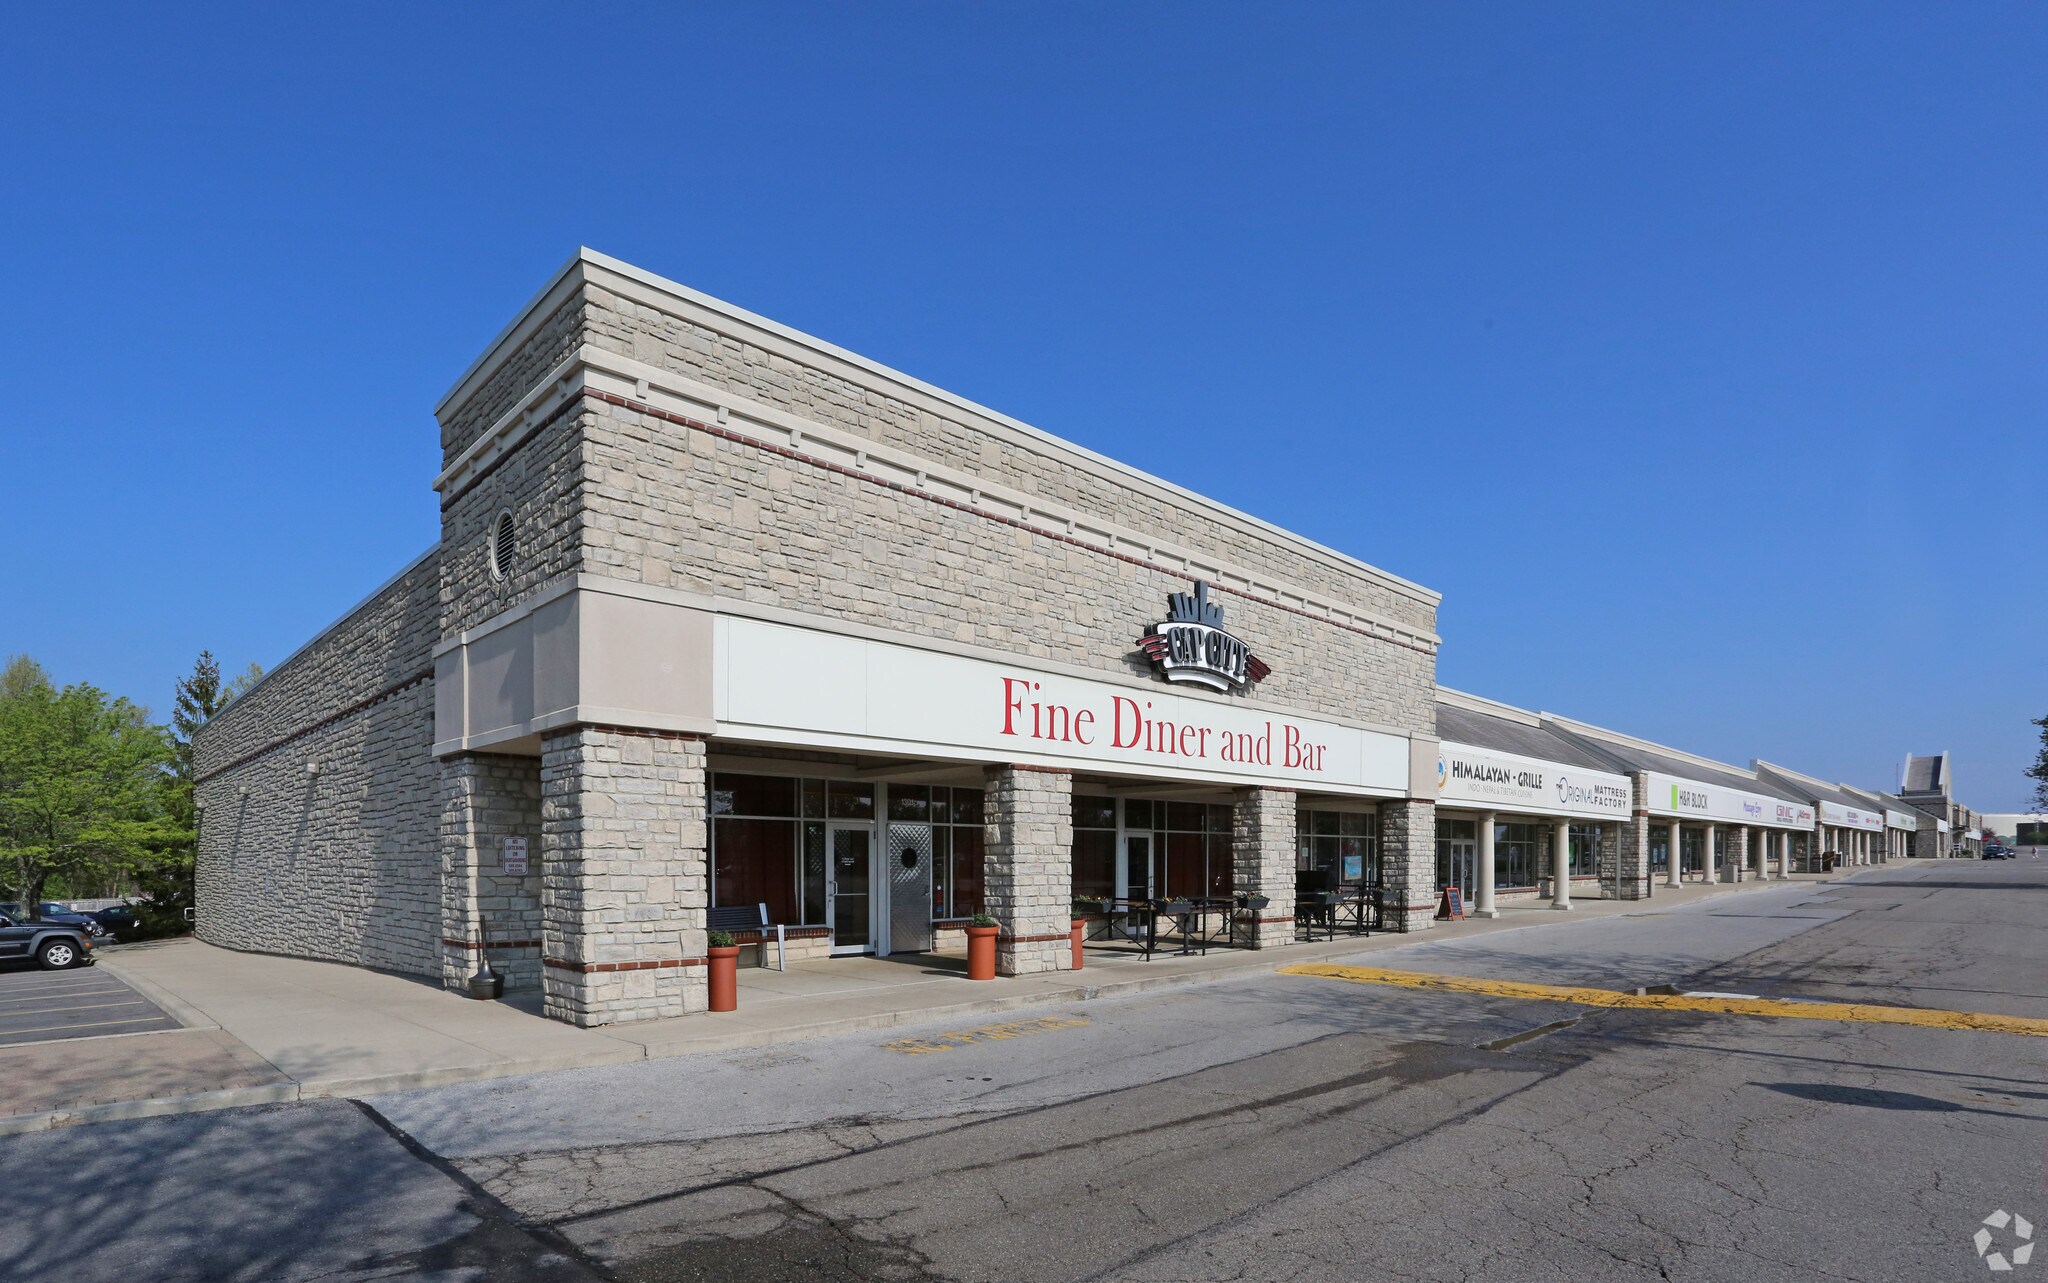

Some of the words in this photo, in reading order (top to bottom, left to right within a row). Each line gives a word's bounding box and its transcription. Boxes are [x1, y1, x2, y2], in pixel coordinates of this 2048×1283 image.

[1167, 625, 1205, 664] CAP
[1204, 629, 1250, 676] CITY
[1000, 676, 1095, 745] Fine
[1110, 695, 1211, 758] Diner
[1221, 721, 1271, 766] and
[1283, 724, 1327, 771] Bar
[1452, 760, 1510, 785] HIMALAYAN
[1518, 771, 1542, 790] GRILLE
[1559, 776, 1594, 804] ORIGINAL
[1594, 785, 1627, 798] MATTRESS
[1679, 789, 1691, 807] H&R
[1691, 792, 1708, 809] BLOCK
[1594, 796, 1627, 809] FACTORY
[1776, 804, 1793, 818] GNC
